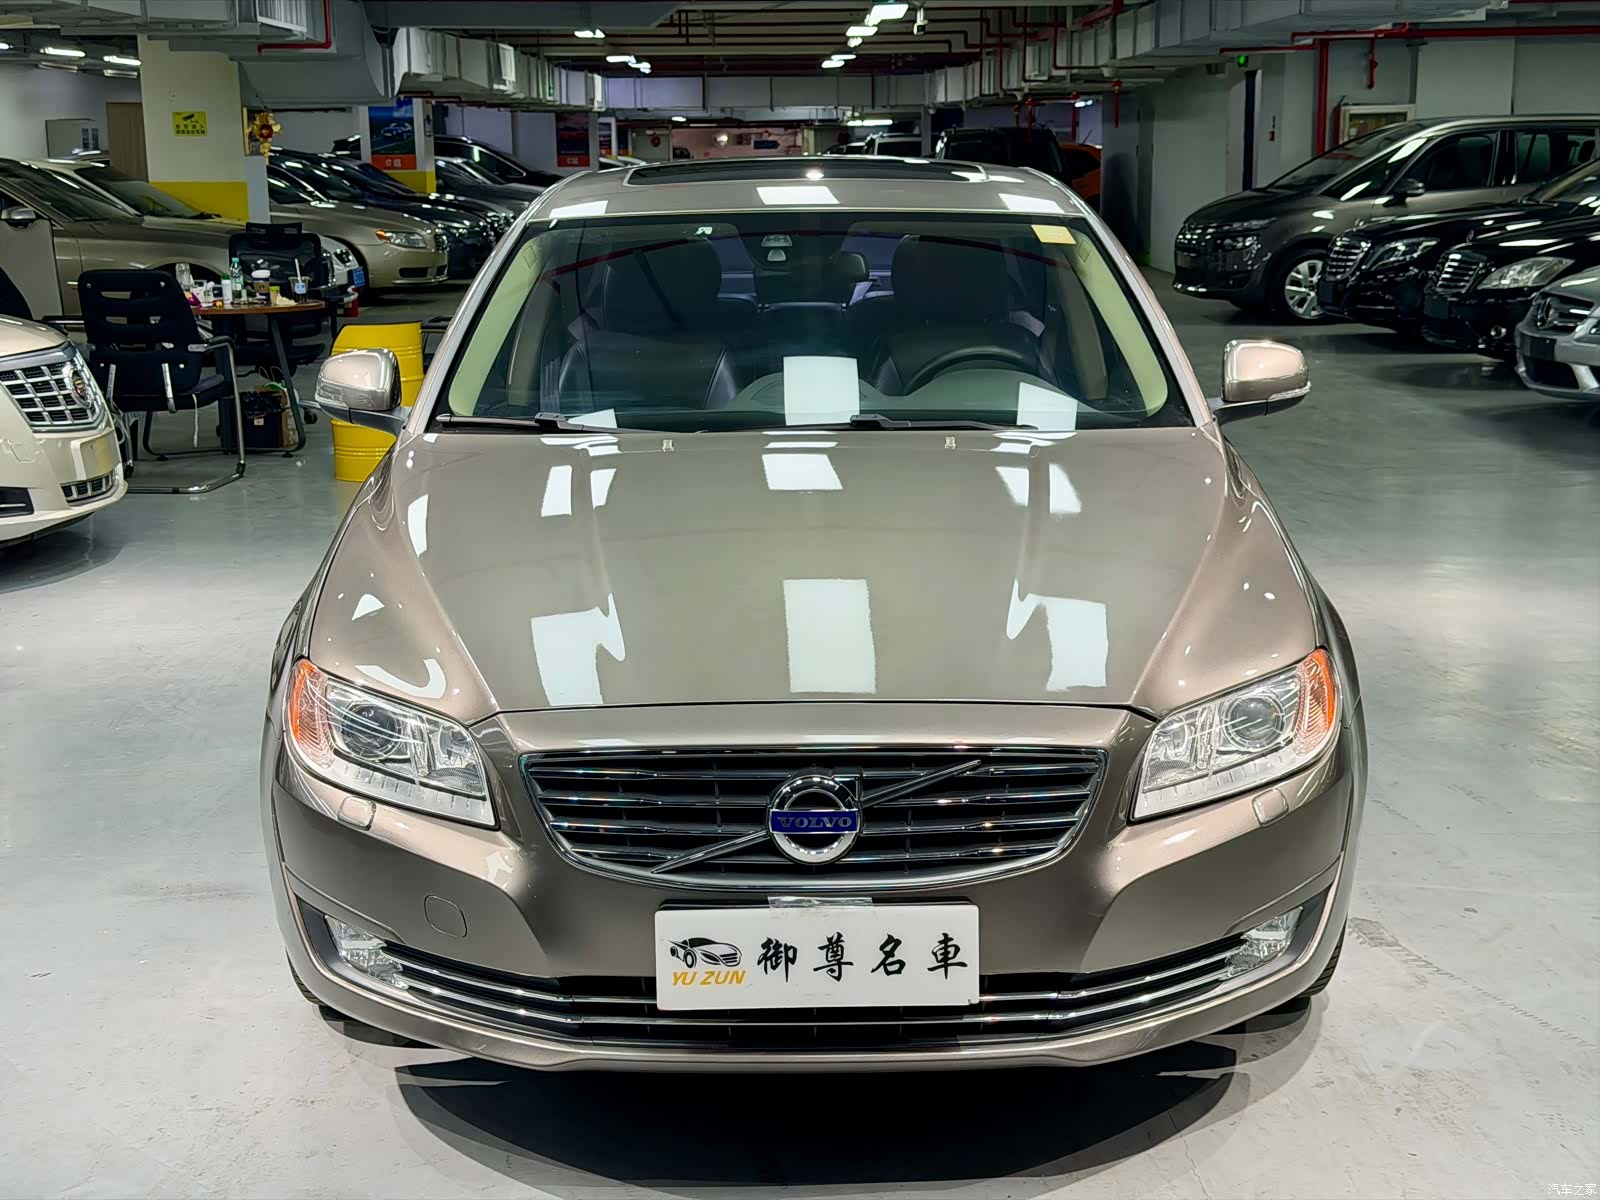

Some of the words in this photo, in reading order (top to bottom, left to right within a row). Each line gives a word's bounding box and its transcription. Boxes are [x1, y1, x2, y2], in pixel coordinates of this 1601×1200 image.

[776, 816, 852, 829] VOLVO
[756, 931, 968, 983] 御尊名車
[672, 971, 698, 986] YU
[700, 970, 747, 986] ZUN
